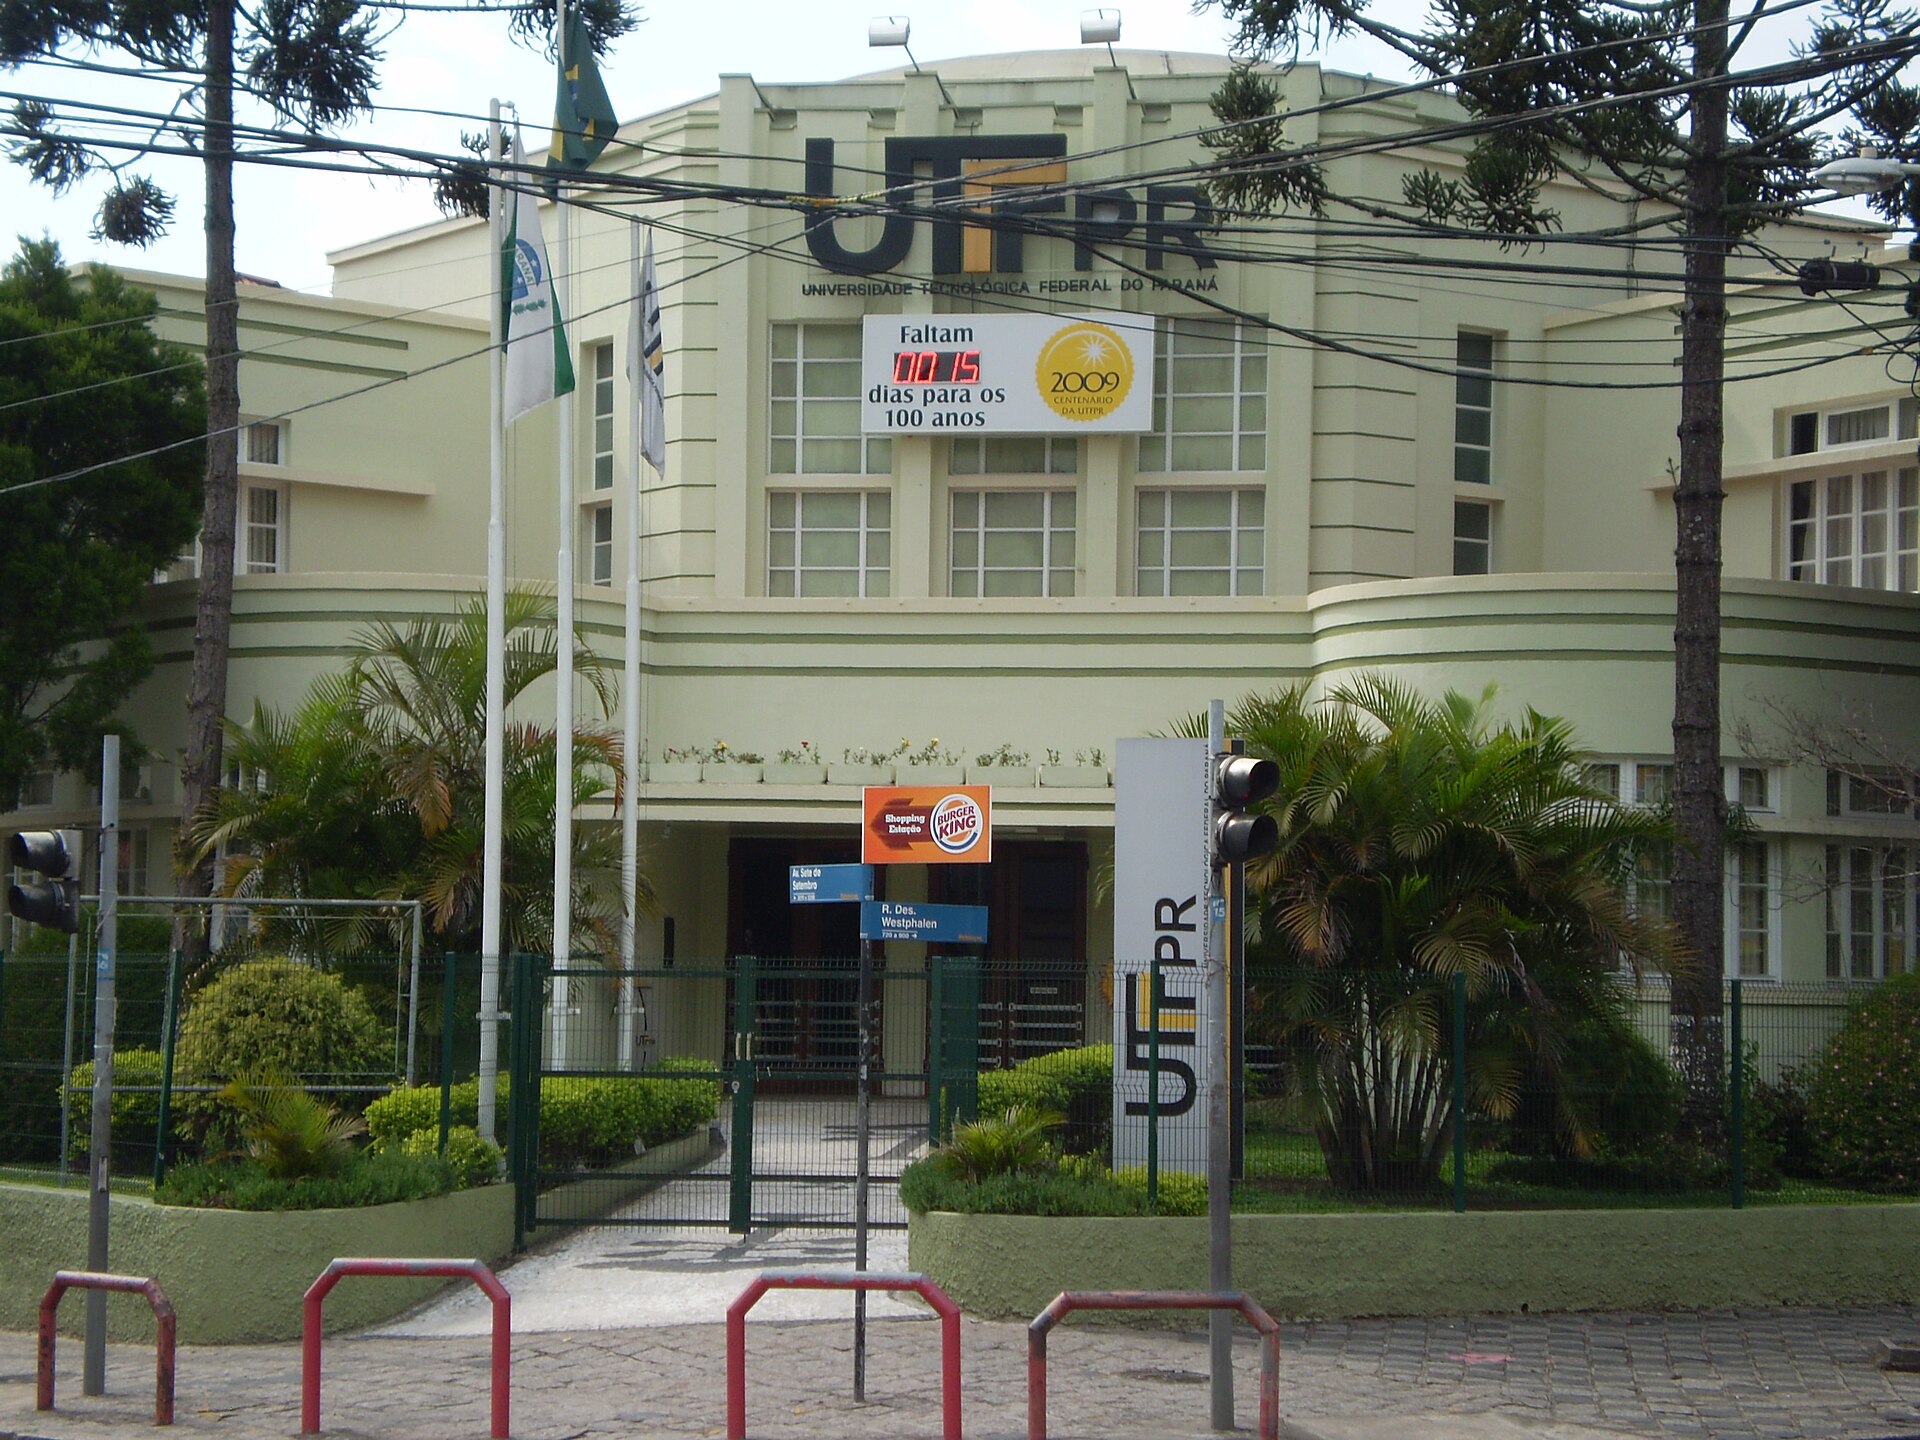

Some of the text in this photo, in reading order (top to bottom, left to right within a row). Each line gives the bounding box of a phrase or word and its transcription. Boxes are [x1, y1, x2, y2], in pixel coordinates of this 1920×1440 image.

[805, 134, 1218, 274] UTFPR
[802, 275, 1218, 297] UNIVERSIDADE TECNOLÓGICA FEDERAL DO PARANÁ
[900, 325, 973, 343] Faltam
[1051, 371, 1120, 393] 2009
[868, 385, 1005, 406] dias para os
[1053, 395, 1113, 405] CENTENÁRIO
[885, 409, 985, 427] 100 anos
[1061, 406, 1104, 416] DA UTFPR
[885, 813, 926, 825] Shopping
[938, 805, 975, 826] BURGER
[889, 824, 922, 835] Estação
[939, 815, 977, 840] KING
[792, 880, 818, 891] Setembro
[882, 904, 917, 915] R. Des.
[882, 917, 938, 930] Westphalen
[1125, 895, 1197, 1117] UTFPR
